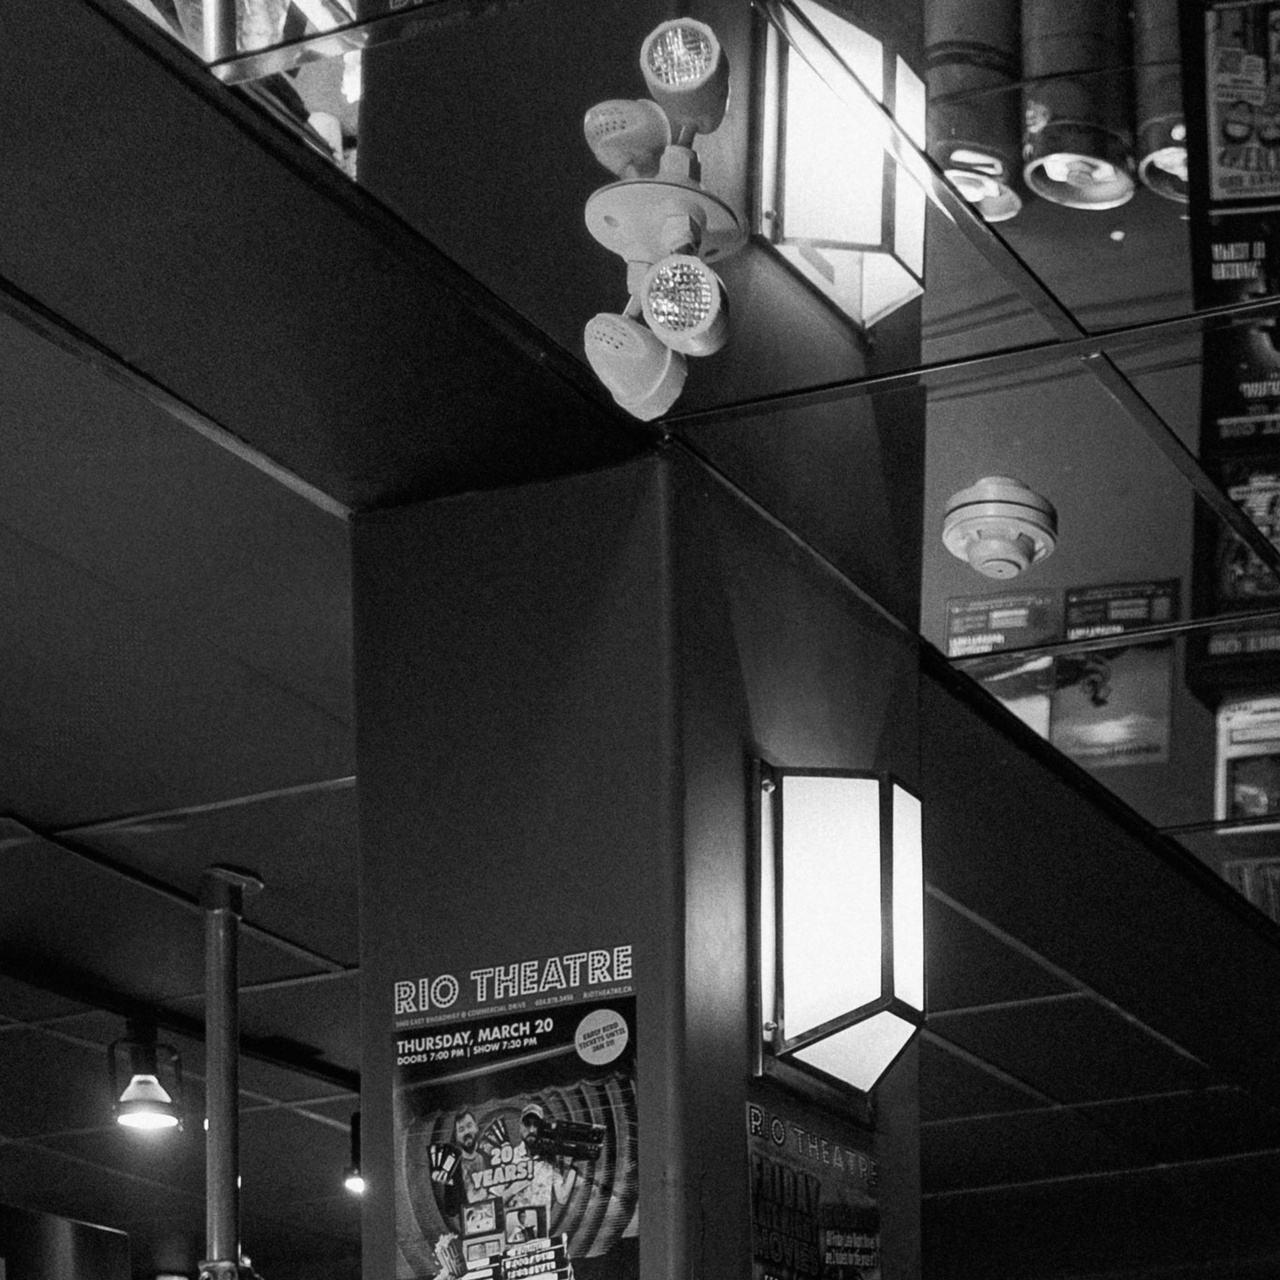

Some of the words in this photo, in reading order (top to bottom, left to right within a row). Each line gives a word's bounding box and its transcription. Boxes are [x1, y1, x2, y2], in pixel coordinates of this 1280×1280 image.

[394, 974, 459, 1015] RIO
[470, 945, 633, 1002] THEATRE
[397, 1031, 474, 1055] THURSDAY,
[478, 1021, 531, 1043] MARCH
[534, 1017, 554, 1033] 20
[397, 1053, 427, 1066] DOORS
[429, 1050, 449, 1062] 7:00
[450, 1048, 464, 1059] PM
[473, 1042, 500, 1055] SHOW
[502, 1039, 521, 1051] 7:30
[523, 1036, 537, 1048] PM
[490, 1144, 514, 1165] 20
[749, 1106, 786, 1146] RIO
[793, 1126, 880, 1187] THEATRE
[471, 1158, 534, 1189] YEARS!
